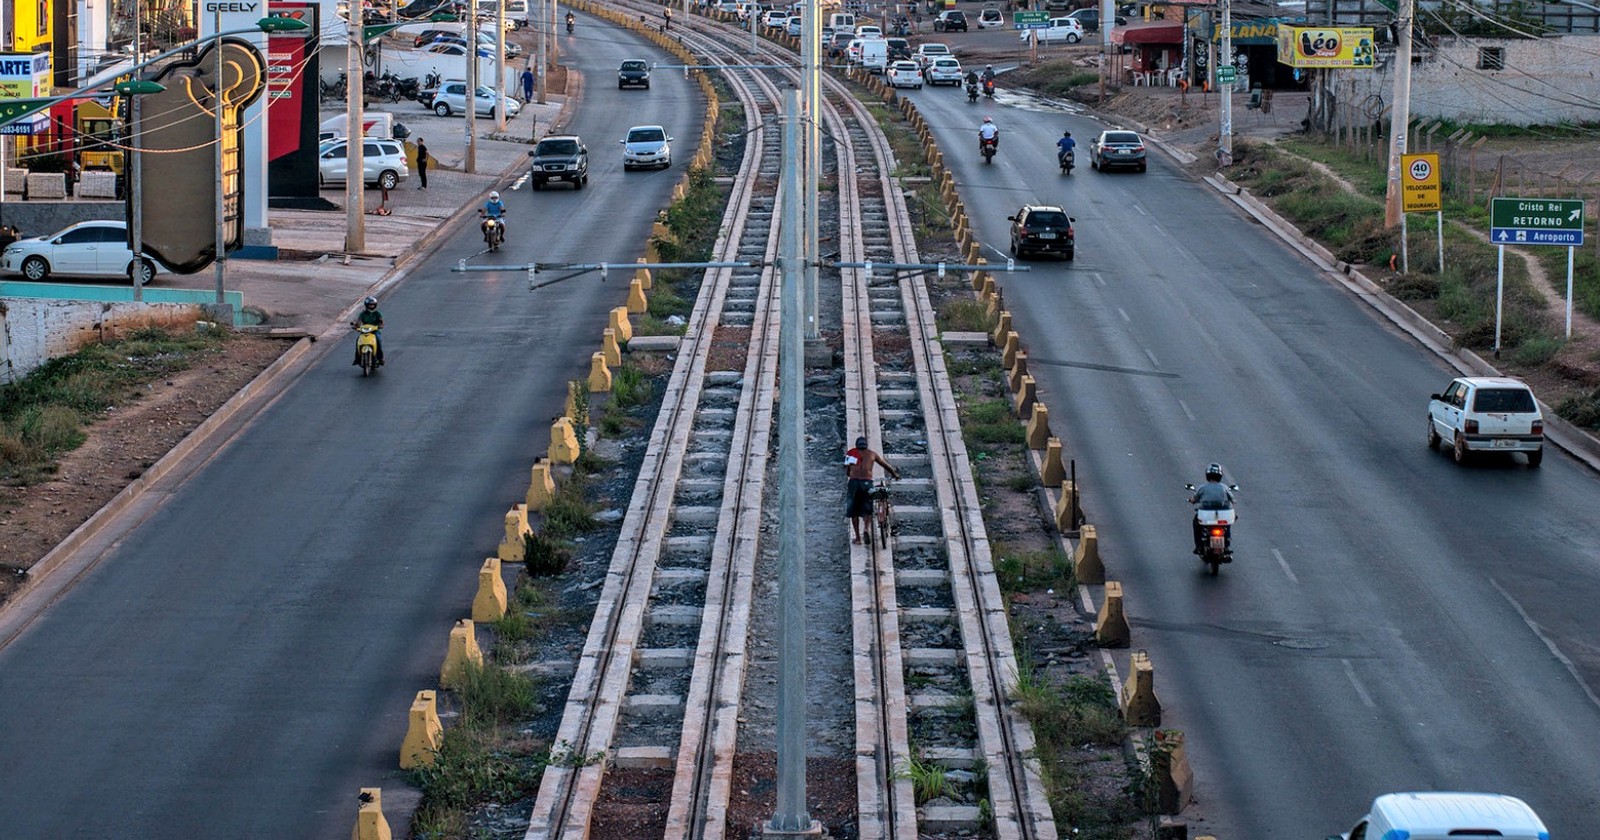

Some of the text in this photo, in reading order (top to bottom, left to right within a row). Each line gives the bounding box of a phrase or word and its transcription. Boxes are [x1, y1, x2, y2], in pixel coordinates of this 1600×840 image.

[206, 2, 258, 12] GEELY
[1413, 164, 1427, 172] 40
[1518, 202, 1563, 212] Cristo Rei
[1513, 216, 1563, 226] RETORNO
[1533, 232, 1575, 242] Aeroporto
